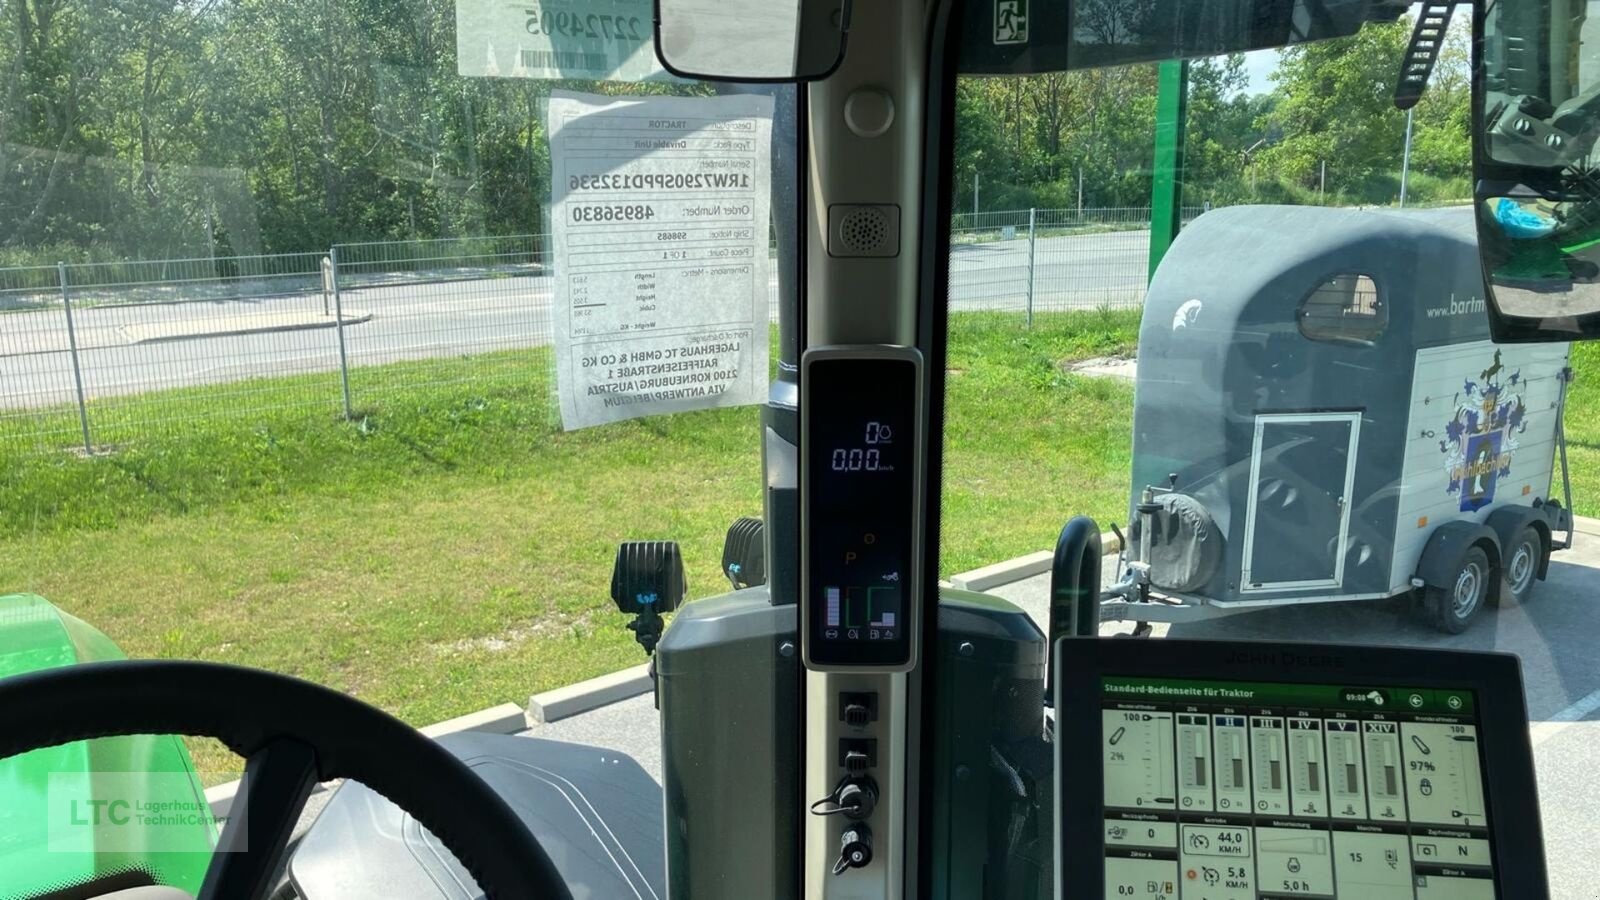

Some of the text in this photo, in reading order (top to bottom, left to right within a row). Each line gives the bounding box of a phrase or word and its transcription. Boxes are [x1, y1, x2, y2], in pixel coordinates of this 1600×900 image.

[865, 422, 880, 443] 0
[845, 552, 857, 564] P
[1224, 651, 1344, 668] JOHN DEERE
[1104, 683, 1255, 699] Standard-Bedienseite für Traktor
[1123, 713, 1141, 722] 100
[1189, 716, 1196, 725] I
[1225, 717, 1235, 727] II
[1260, 719, 1274, 729] III
[1297, 720, 1312, 730] IV
[1337, 722, 1348, 732] V
[1368, 723, 1392, 734] XIV
[1450, 726, 1466, 734] 100
[1109, 751, 1125, 761] 2%
[1410, 760, 1436, 772] 97%
[1136, 797, 1142, 806] 0
[1148, 828, 1155, 839] 0
[1217, 832, 1242, 844] 44,0
[1218, 845, 1242, 855] KM/H
[1458, 845, 1469, 856] N
[1349, 852, 1363, 863] 15
[1228, 867, 1246, 879] 5,8
[1225, 880, 1249, 889] KM/H
[1283, 879, 1310, 892] 5,0 h
[1118, 885, 1135, 897] 0,0
